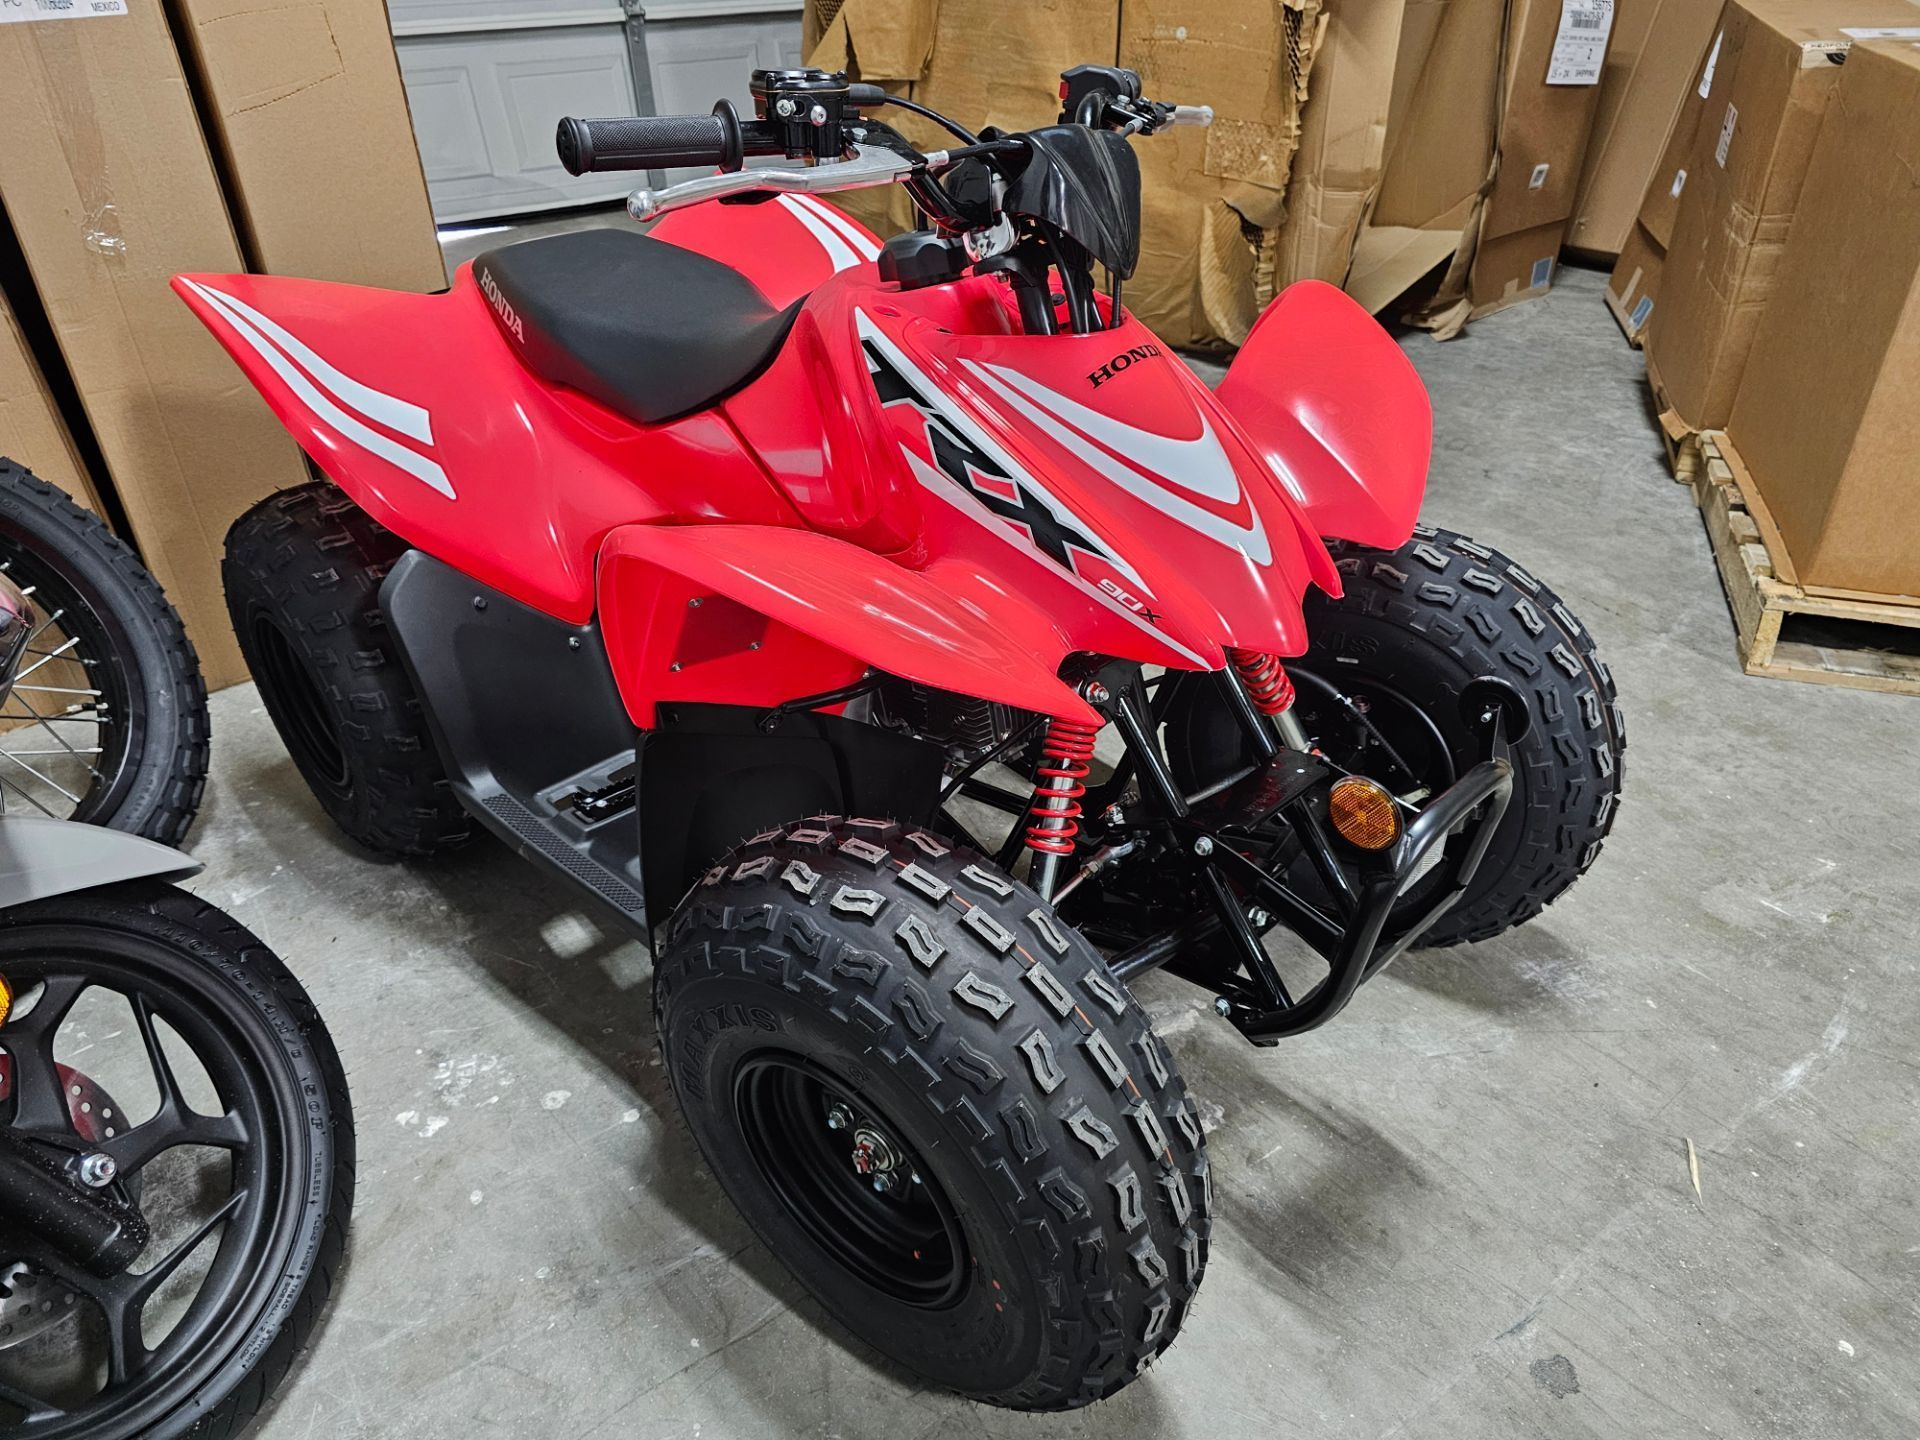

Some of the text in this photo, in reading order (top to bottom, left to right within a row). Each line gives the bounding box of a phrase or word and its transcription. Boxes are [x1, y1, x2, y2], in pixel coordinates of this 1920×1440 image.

[91, 2, 120, 12] MEXICO
[480, 266, 525, 345] HONDA
[680, 1003, 778, 1100] MAXXIS
[311, 1151, 322, 1197] TUBELESS
